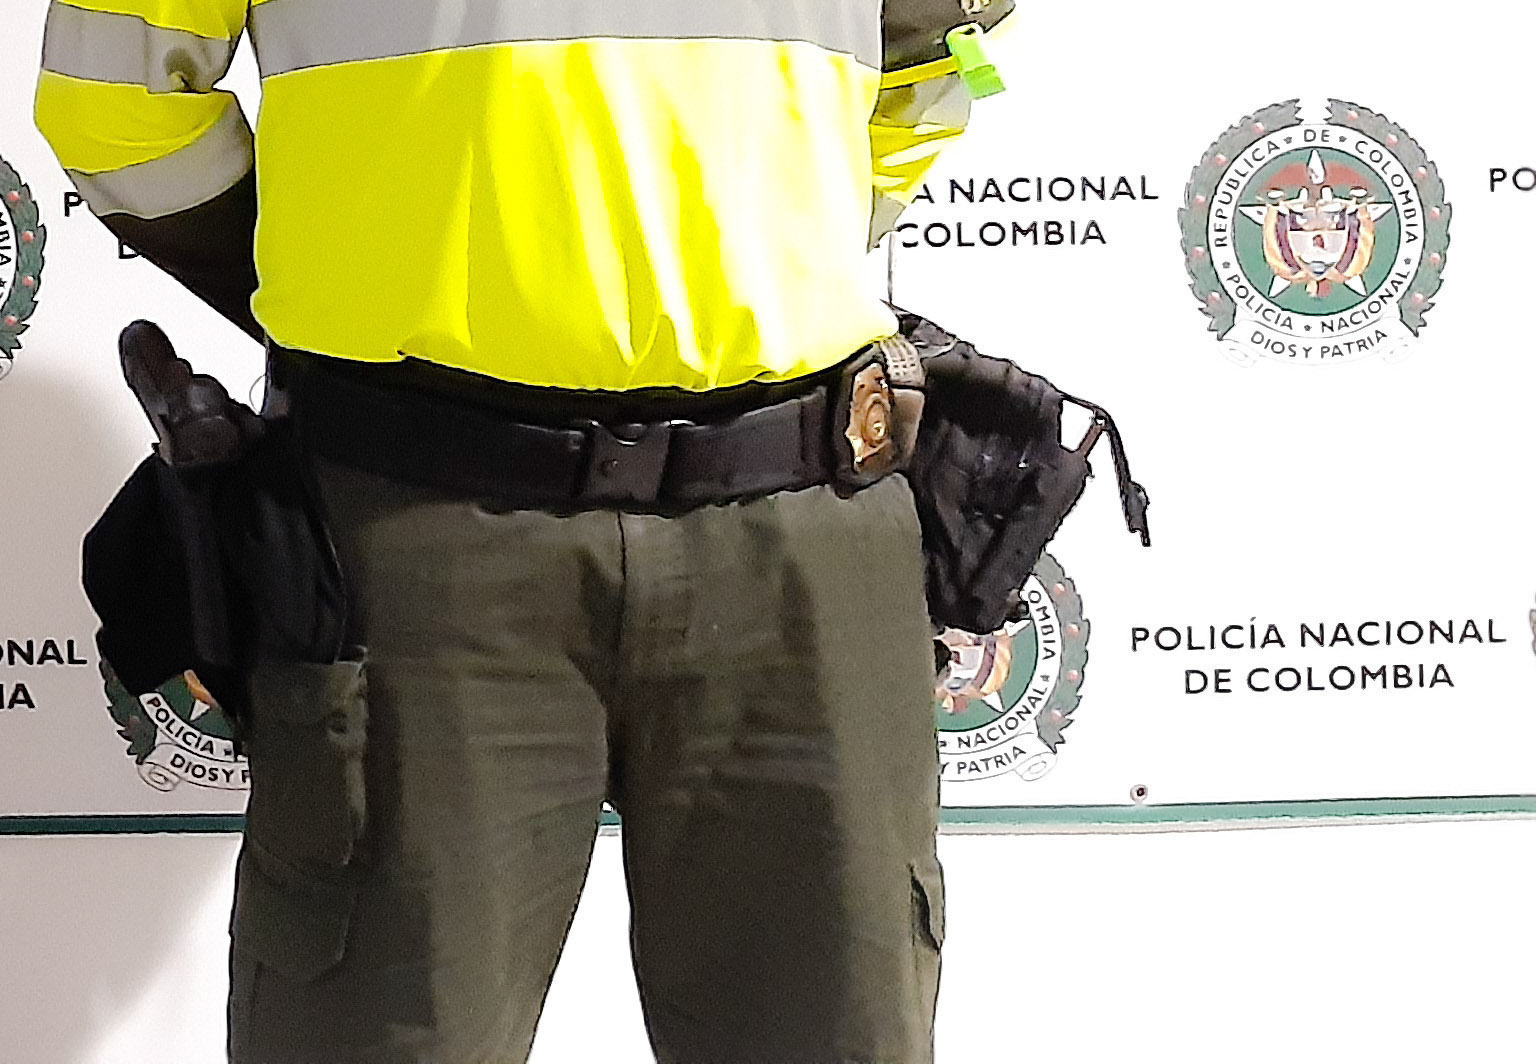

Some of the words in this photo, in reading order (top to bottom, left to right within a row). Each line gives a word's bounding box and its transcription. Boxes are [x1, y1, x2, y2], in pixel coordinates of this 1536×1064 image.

[949, 175, 1158, 203] NACIONAL
[1303, 129, 1331, 143] DE
[1355, 139, 1419, 245] COLOMBIA
[1320, 270, 1411, 333] NACIONAL
[1320, 329, 1389, 359] PATRIA
[1132, 617, 1285, 652] POLICÍA
[1301, 619, 1506, 647] NACIONAL
[1185, 669, 1232, 694] DE
[1247, 664, 1454, 692] COLOMBIA
